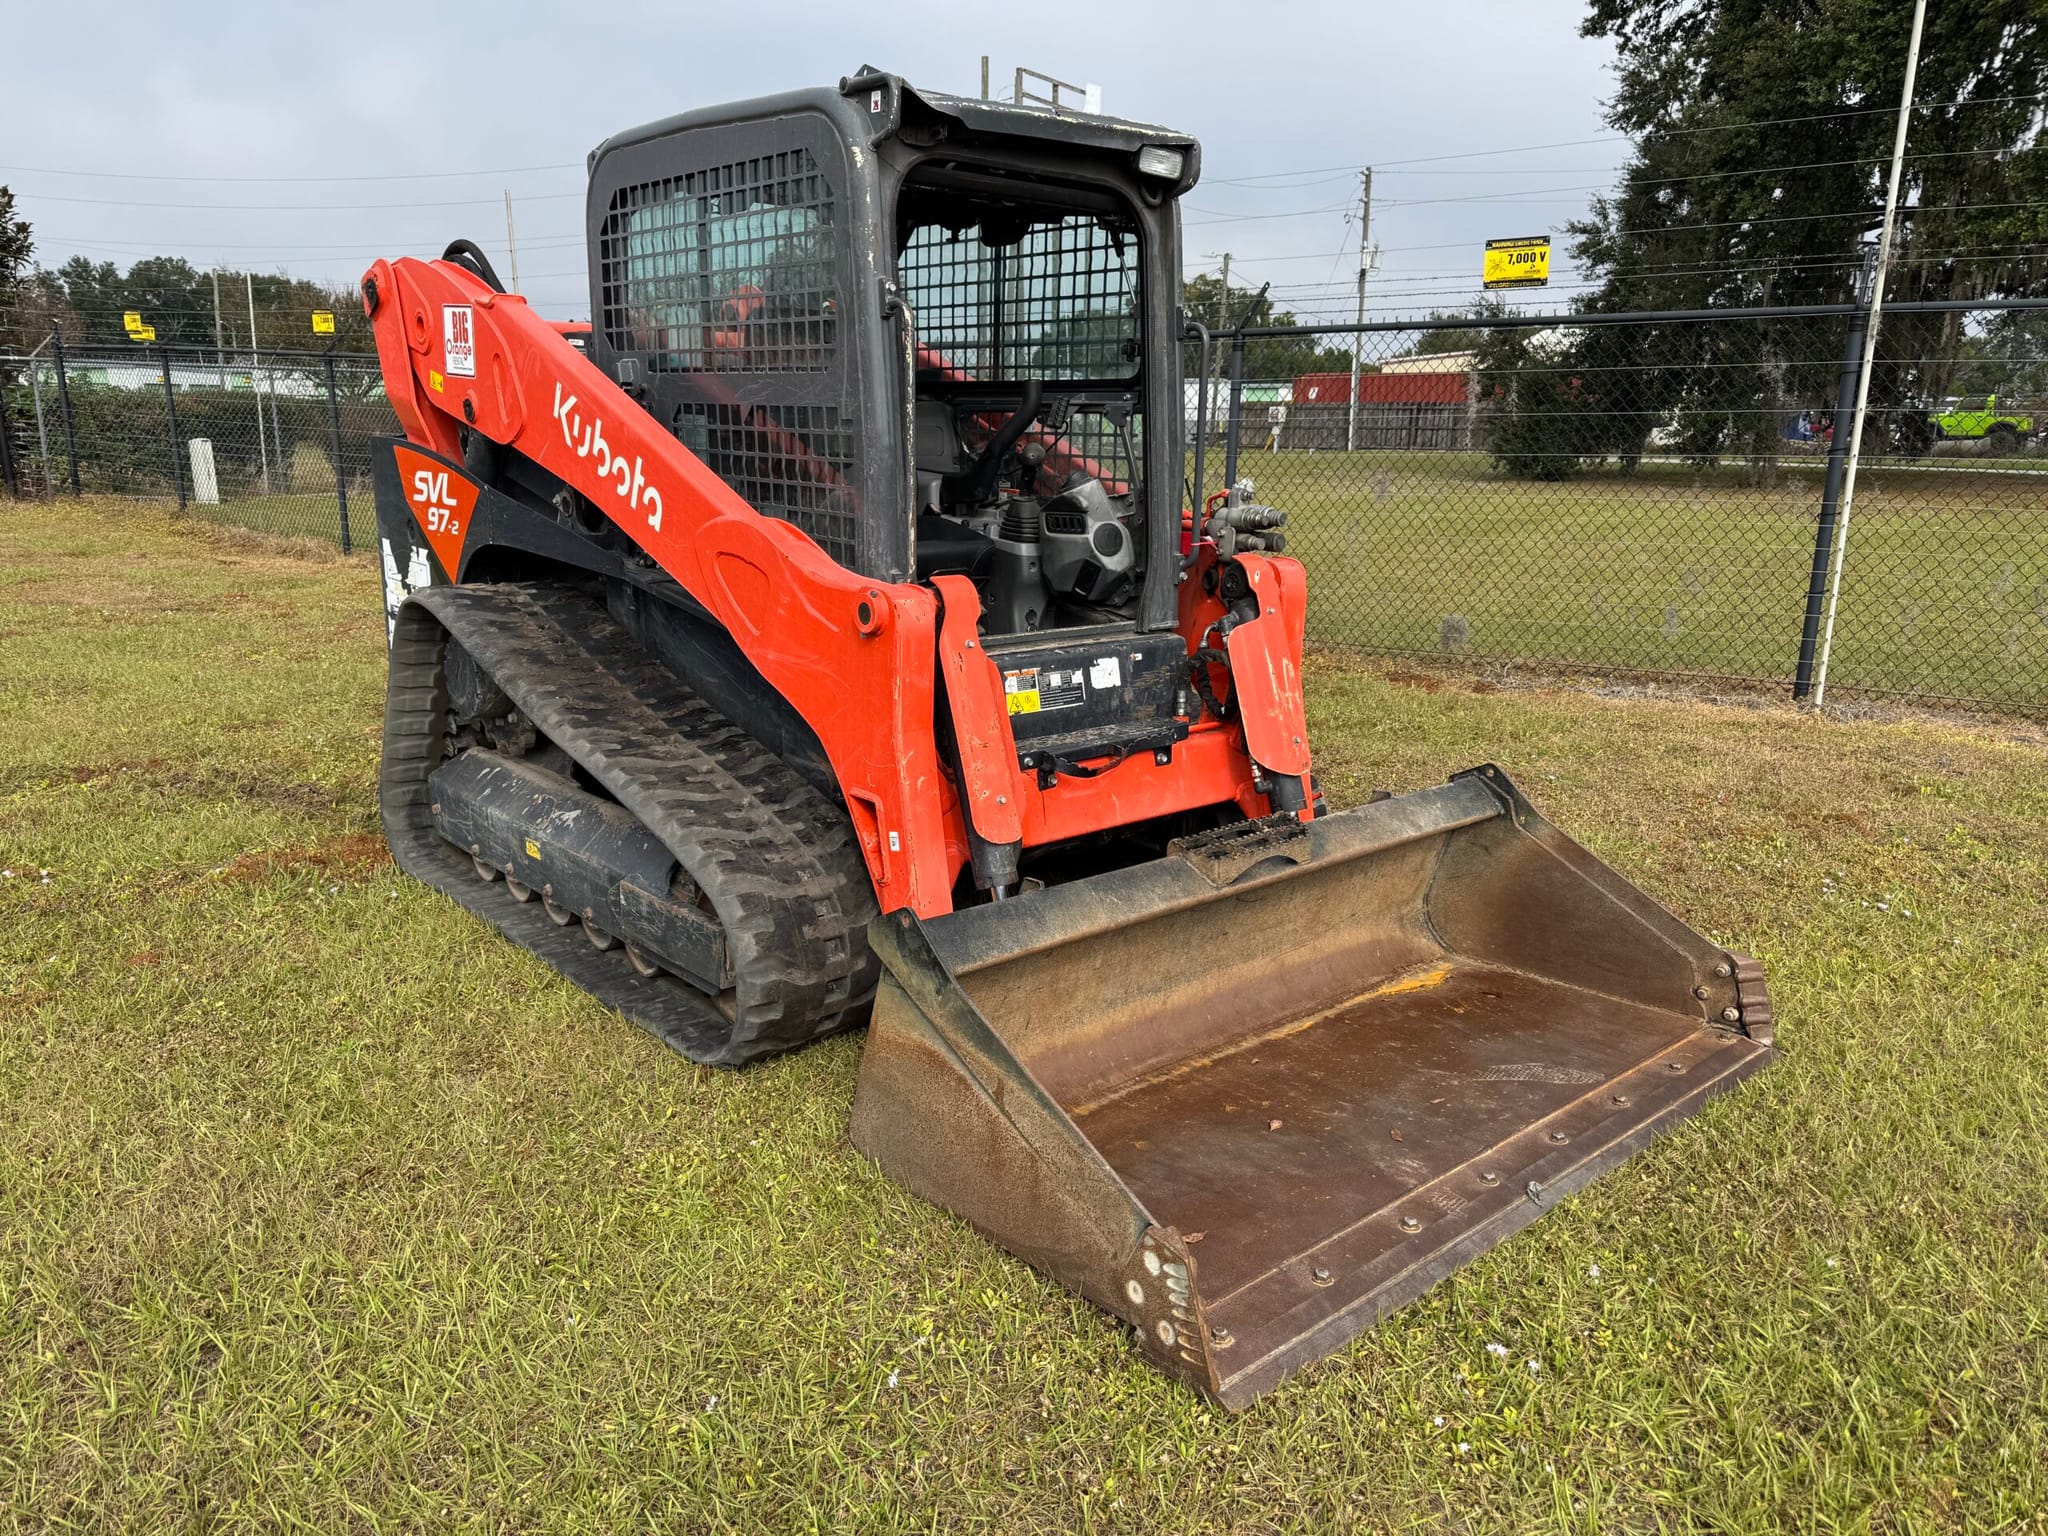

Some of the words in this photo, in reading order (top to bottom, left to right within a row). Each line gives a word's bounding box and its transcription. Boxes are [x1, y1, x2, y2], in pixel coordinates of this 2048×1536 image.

[1507, 252, 1537, 266] 7,000
[1539, 251, 1546, 262] V
[451, 310, 469, 344] BIG
[446, 338, 472, 361] Orange
[553, 381, 663, 533] Kubota
[413, 470, 457, 506] SVL
[427, 507, 460, 535] 97-2
